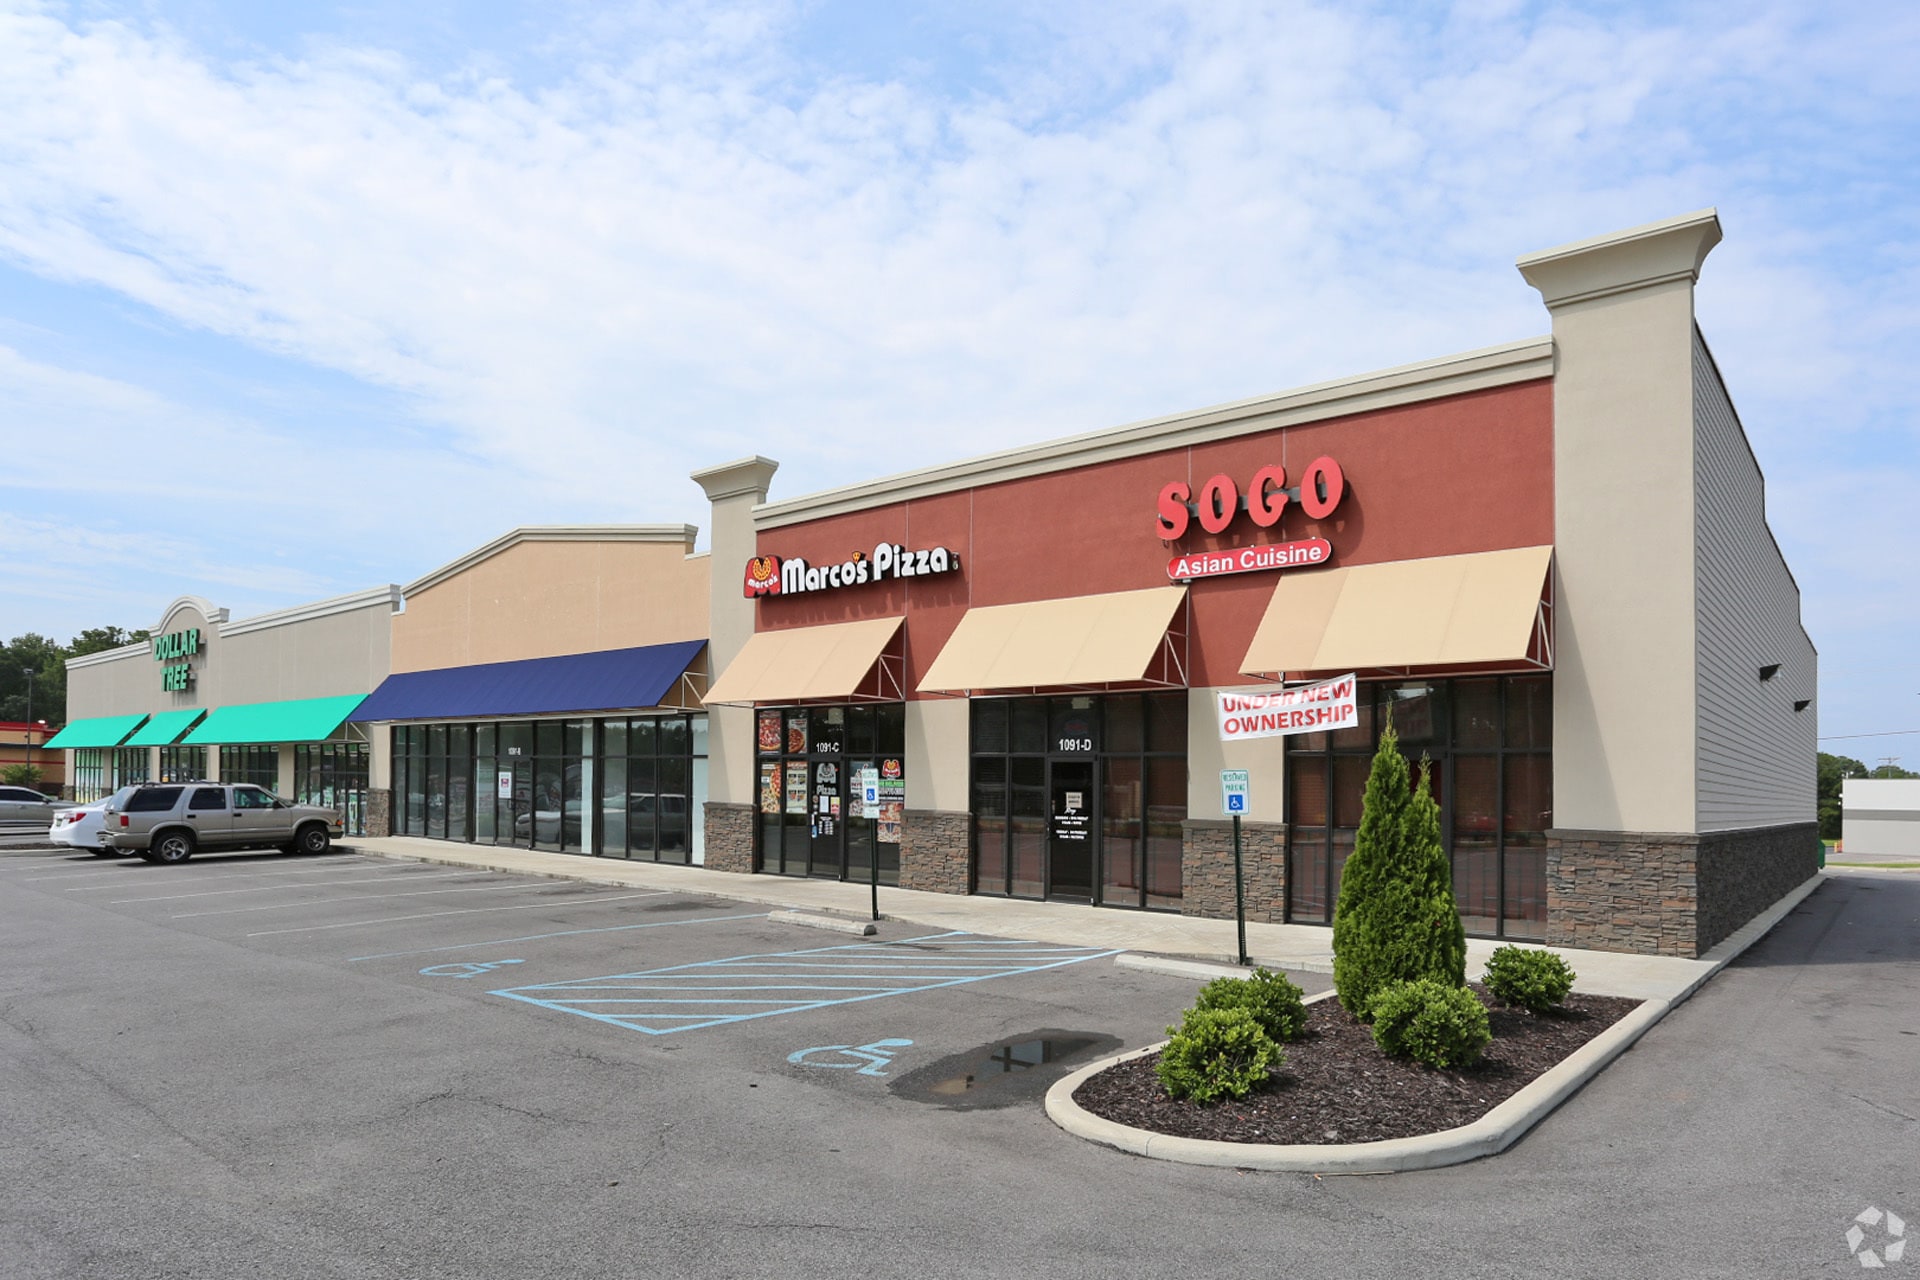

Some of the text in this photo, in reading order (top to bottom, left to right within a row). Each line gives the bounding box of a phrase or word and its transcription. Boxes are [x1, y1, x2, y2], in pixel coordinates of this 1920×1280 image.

[1156, 456, 1344, 540] SOGO
[782, 542, 949, 595] Marco's Pizza
[1175, 545, 1322, 576] Asian Cuisine
[154, 628, 199, 662] DOLLAR
[160, 663, 190, 692] TREE
[1223, 679, 1353, 713] UNDER NEW
[1224, 703, 1353, 734] OWNERSHIP
[816, 742, 839, 752] 1091-C
[1059, 739, 1091, 751] 1091-D
